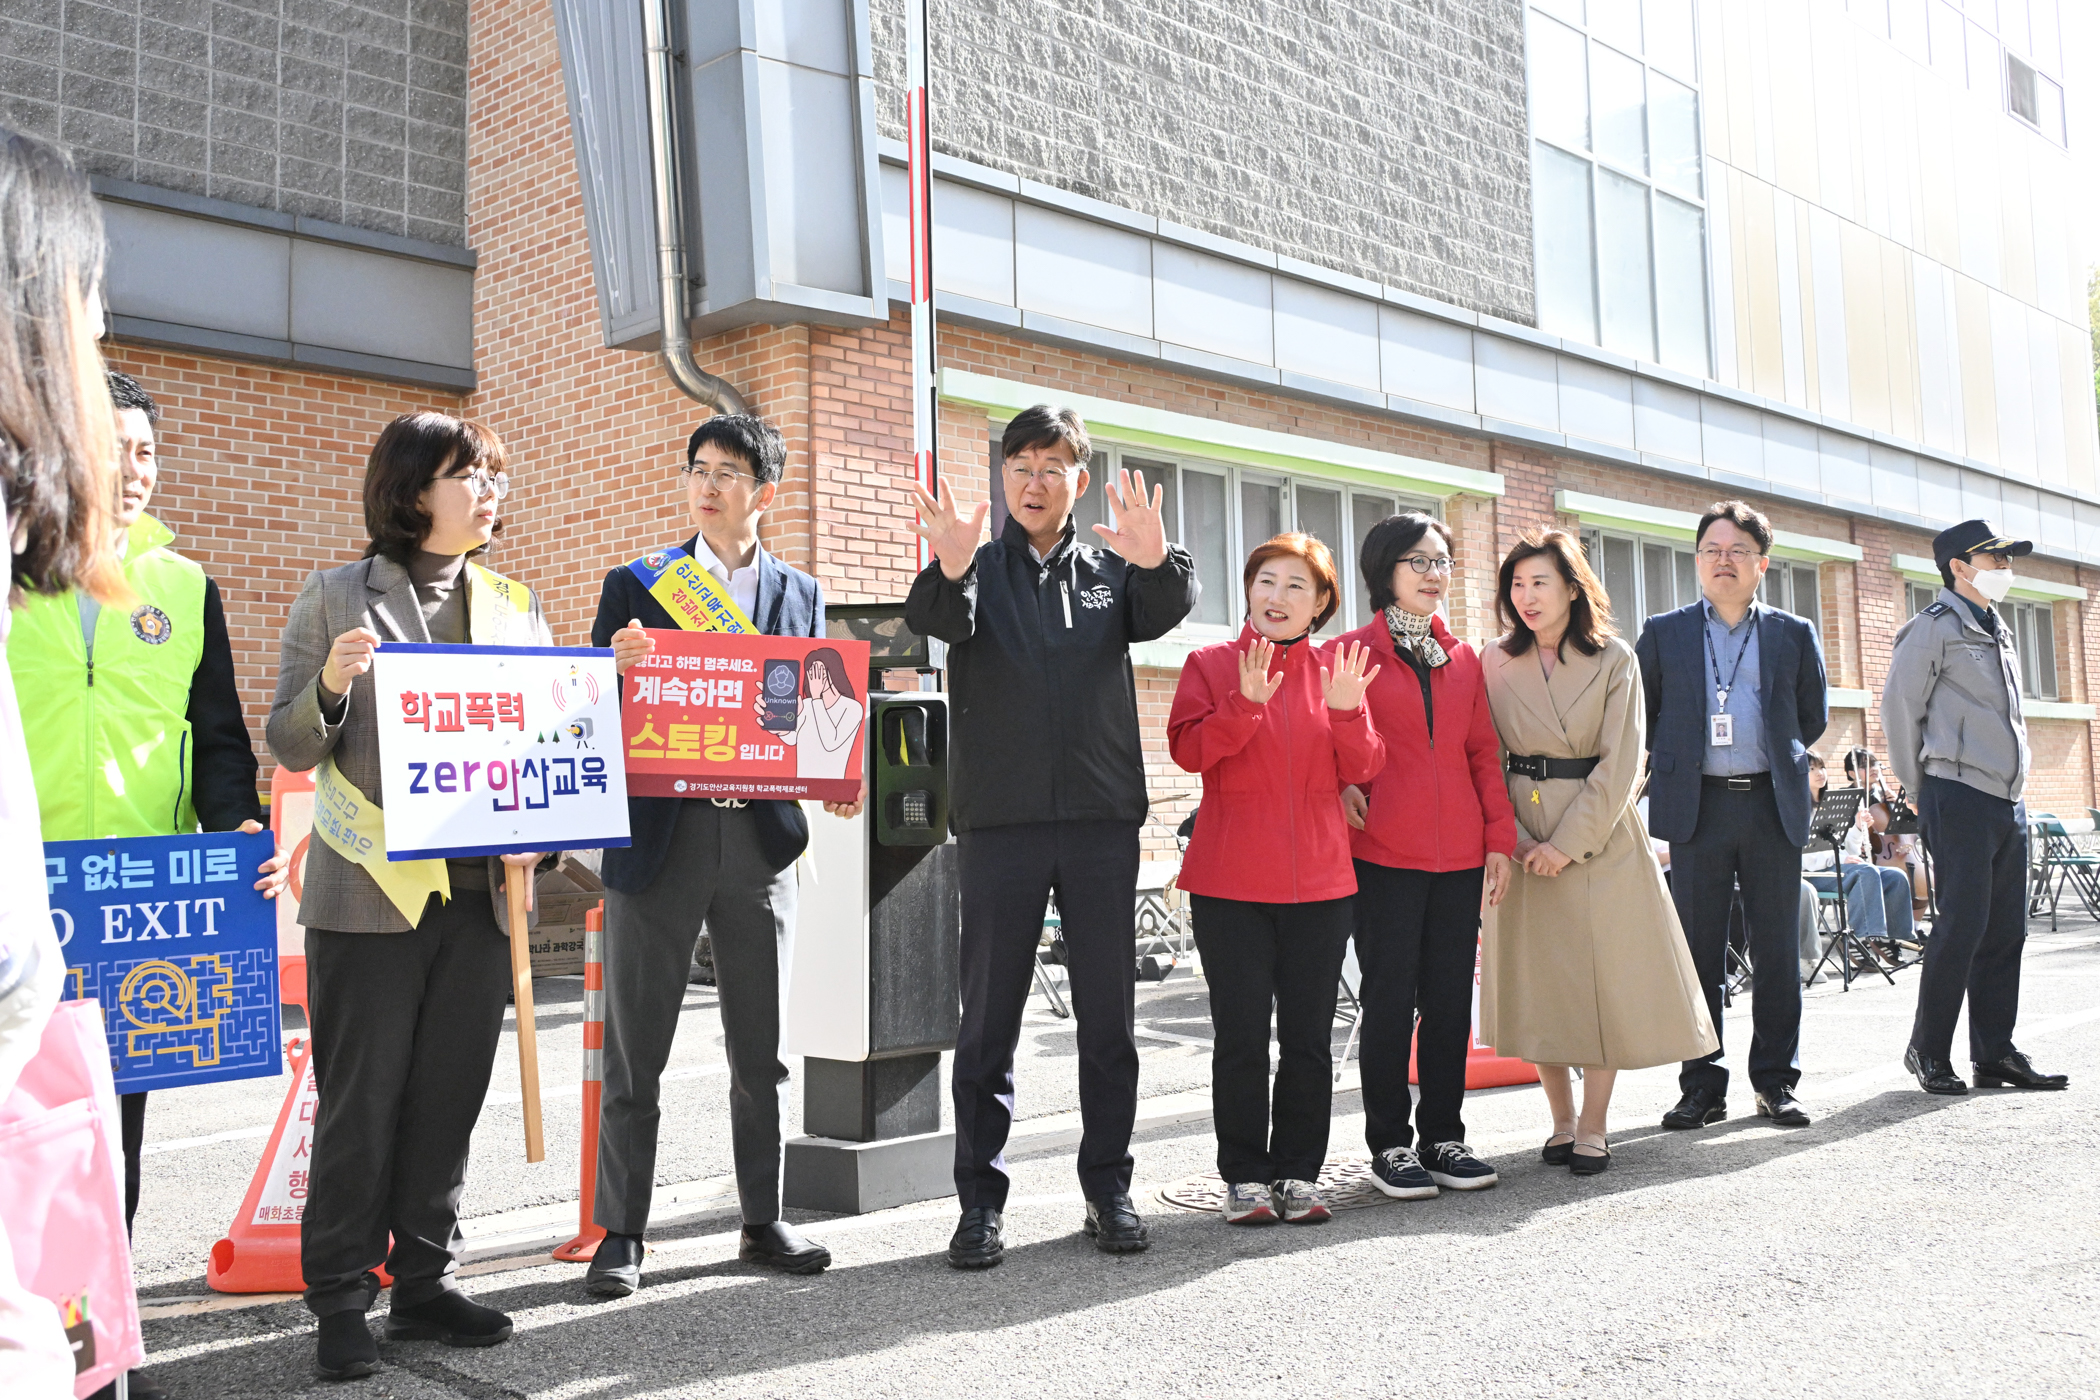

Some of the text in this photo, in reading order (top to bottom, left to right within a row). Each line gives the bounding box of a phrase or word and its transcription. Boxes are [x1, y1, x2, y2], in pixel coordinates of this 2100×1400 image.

[672, 588, 710, 628] 성범죄
[676, 656, 702, 670] 하면
[704, 659, 758, 673] 멈추세요.
[633, 676, 743, 708] 계속하면
[765, 697, 797, 705] Unknown
[400, 690, 525, 733] 학교폭력
[629, 721, 785, 762] 스토킹 입니다
[689, 783, 808, 793] 경기도안산교육지원청 학교폭력제로센터
[82, 853, 155, 892] 없는
[169, 848, 239, 884] 미로
[100, 897, 225, 945] EXIT
[553, 940, 584, 953] 과학강국
